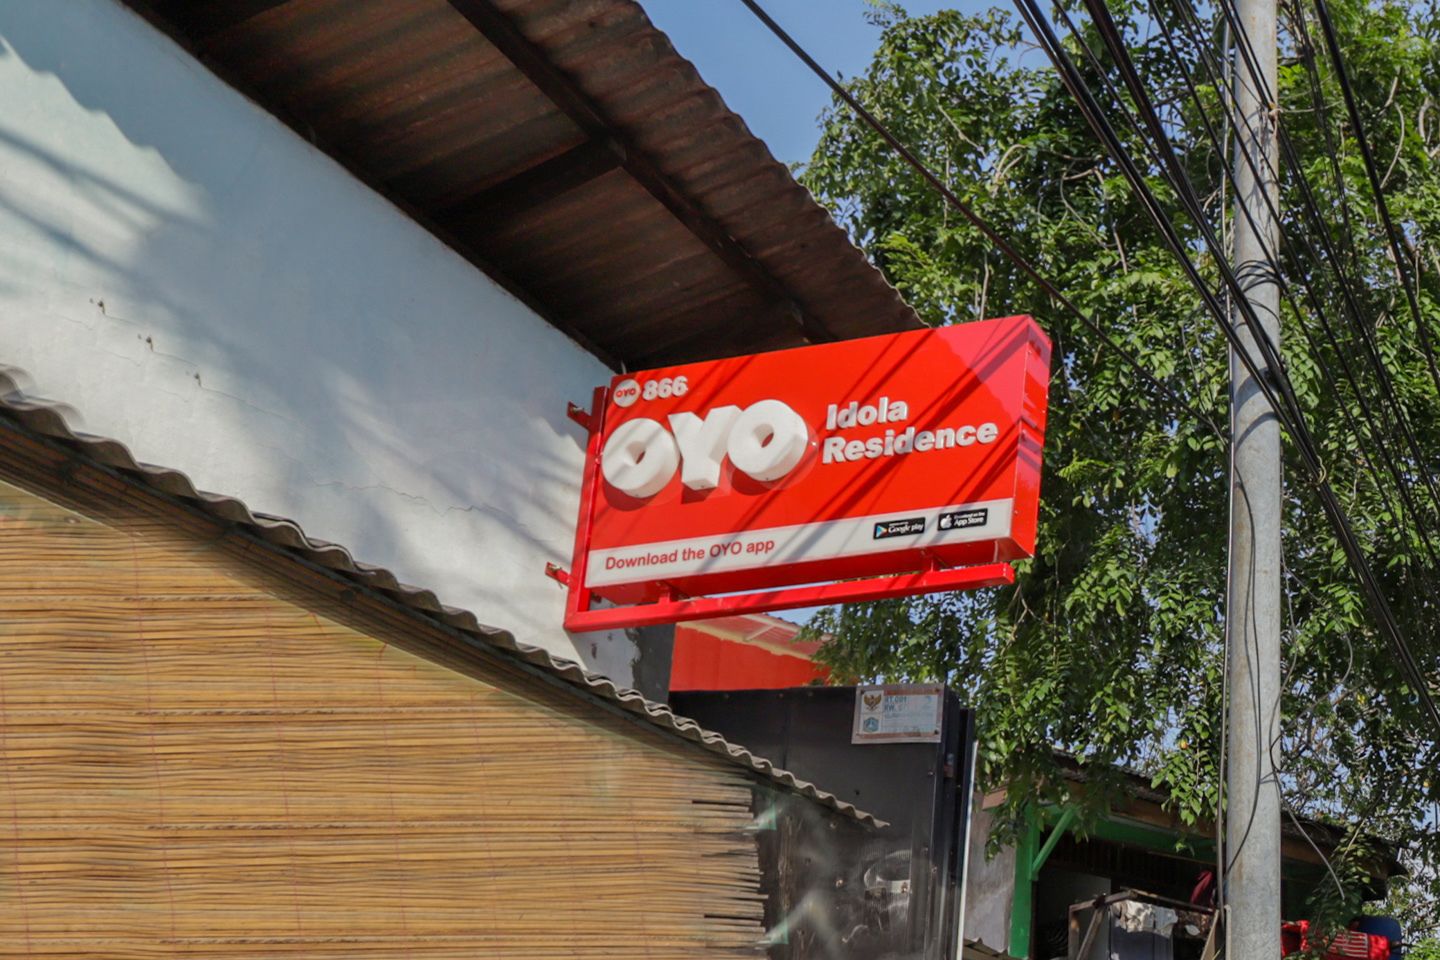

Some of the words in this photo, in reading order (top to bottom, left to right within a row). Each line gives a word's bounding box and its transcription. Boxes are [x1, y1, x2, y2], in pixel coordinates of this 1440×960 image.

[615, 387, 637, 399] OYO
[642, 376, 688, 401] 866
[826, 397, 909, 430] Idola
[602, 399, 808, 498] OYO
[822, 422, 998, 464] Residence
[889, 524, 910, 534] Google
[954, 518, 968, 527] App
[968, 516, 984, 525] Store
[605, 551, 678, 570] Download
[682, 547, 705, 561] the
[709, 541, 742, 558] OYO
[746, 540, 775, 555] app
